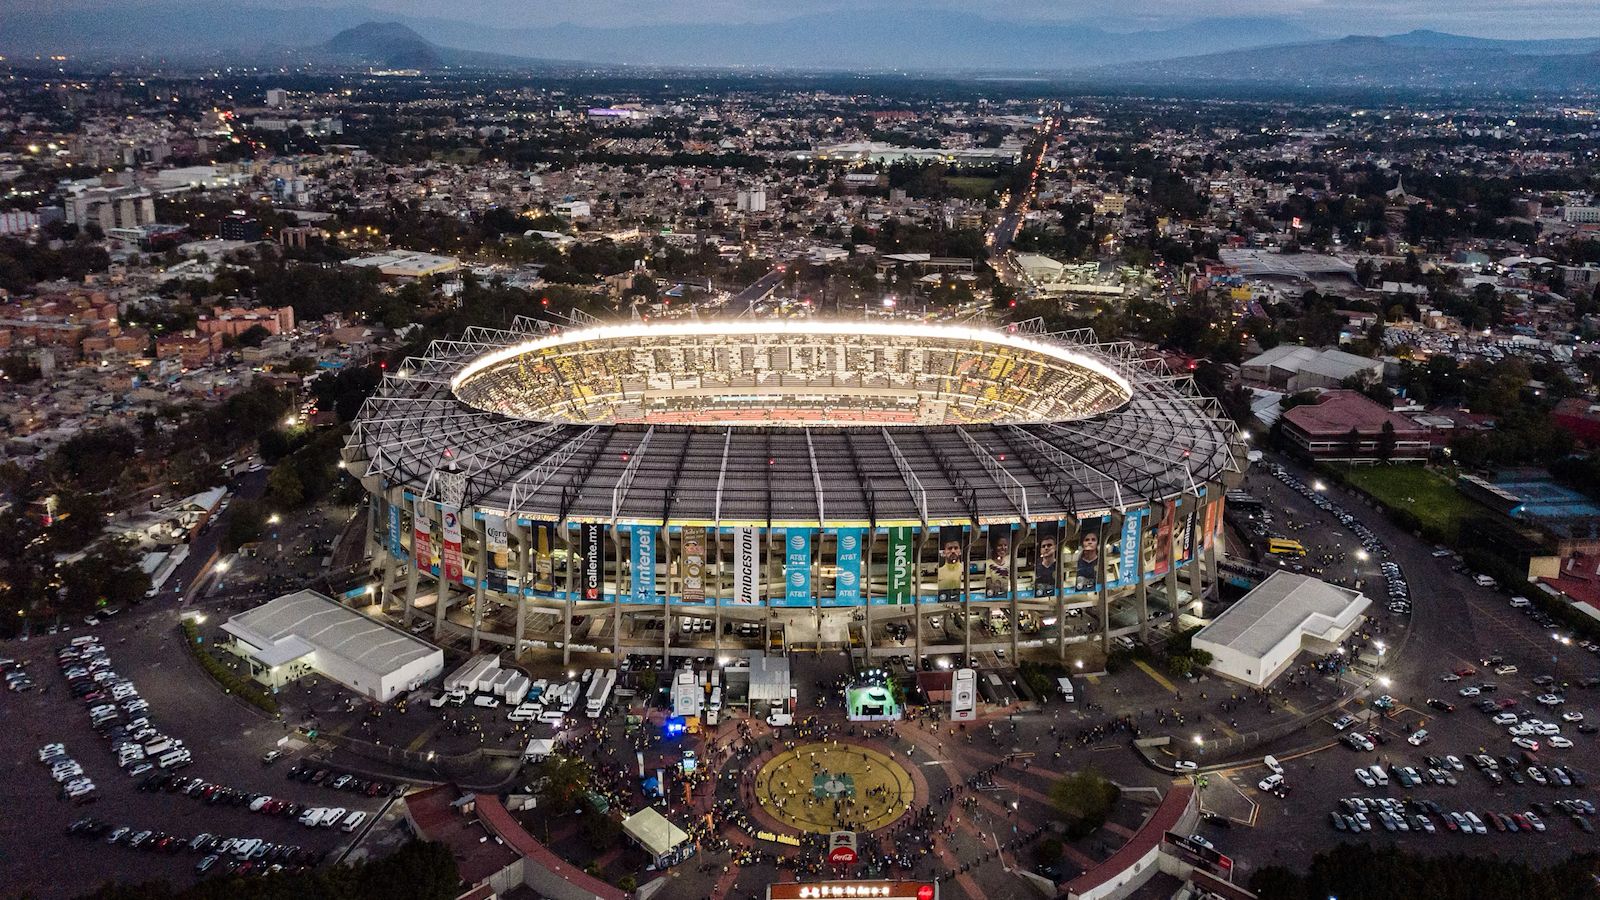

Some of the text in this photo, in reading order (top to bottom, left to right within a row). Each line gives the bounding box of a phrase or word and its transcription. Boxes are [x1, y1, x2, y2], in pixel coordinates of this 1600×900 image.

[444, 527, 460, 537] TOTAL
[586, 524, 598, 588] caliente.mx
[741, 528, 752, 604] BRIDGESTONE
[840, 553, 858, 561] AT&T
[894, 544, 906, 589] TUDN
[838, 589, 856, 597] AT&T
